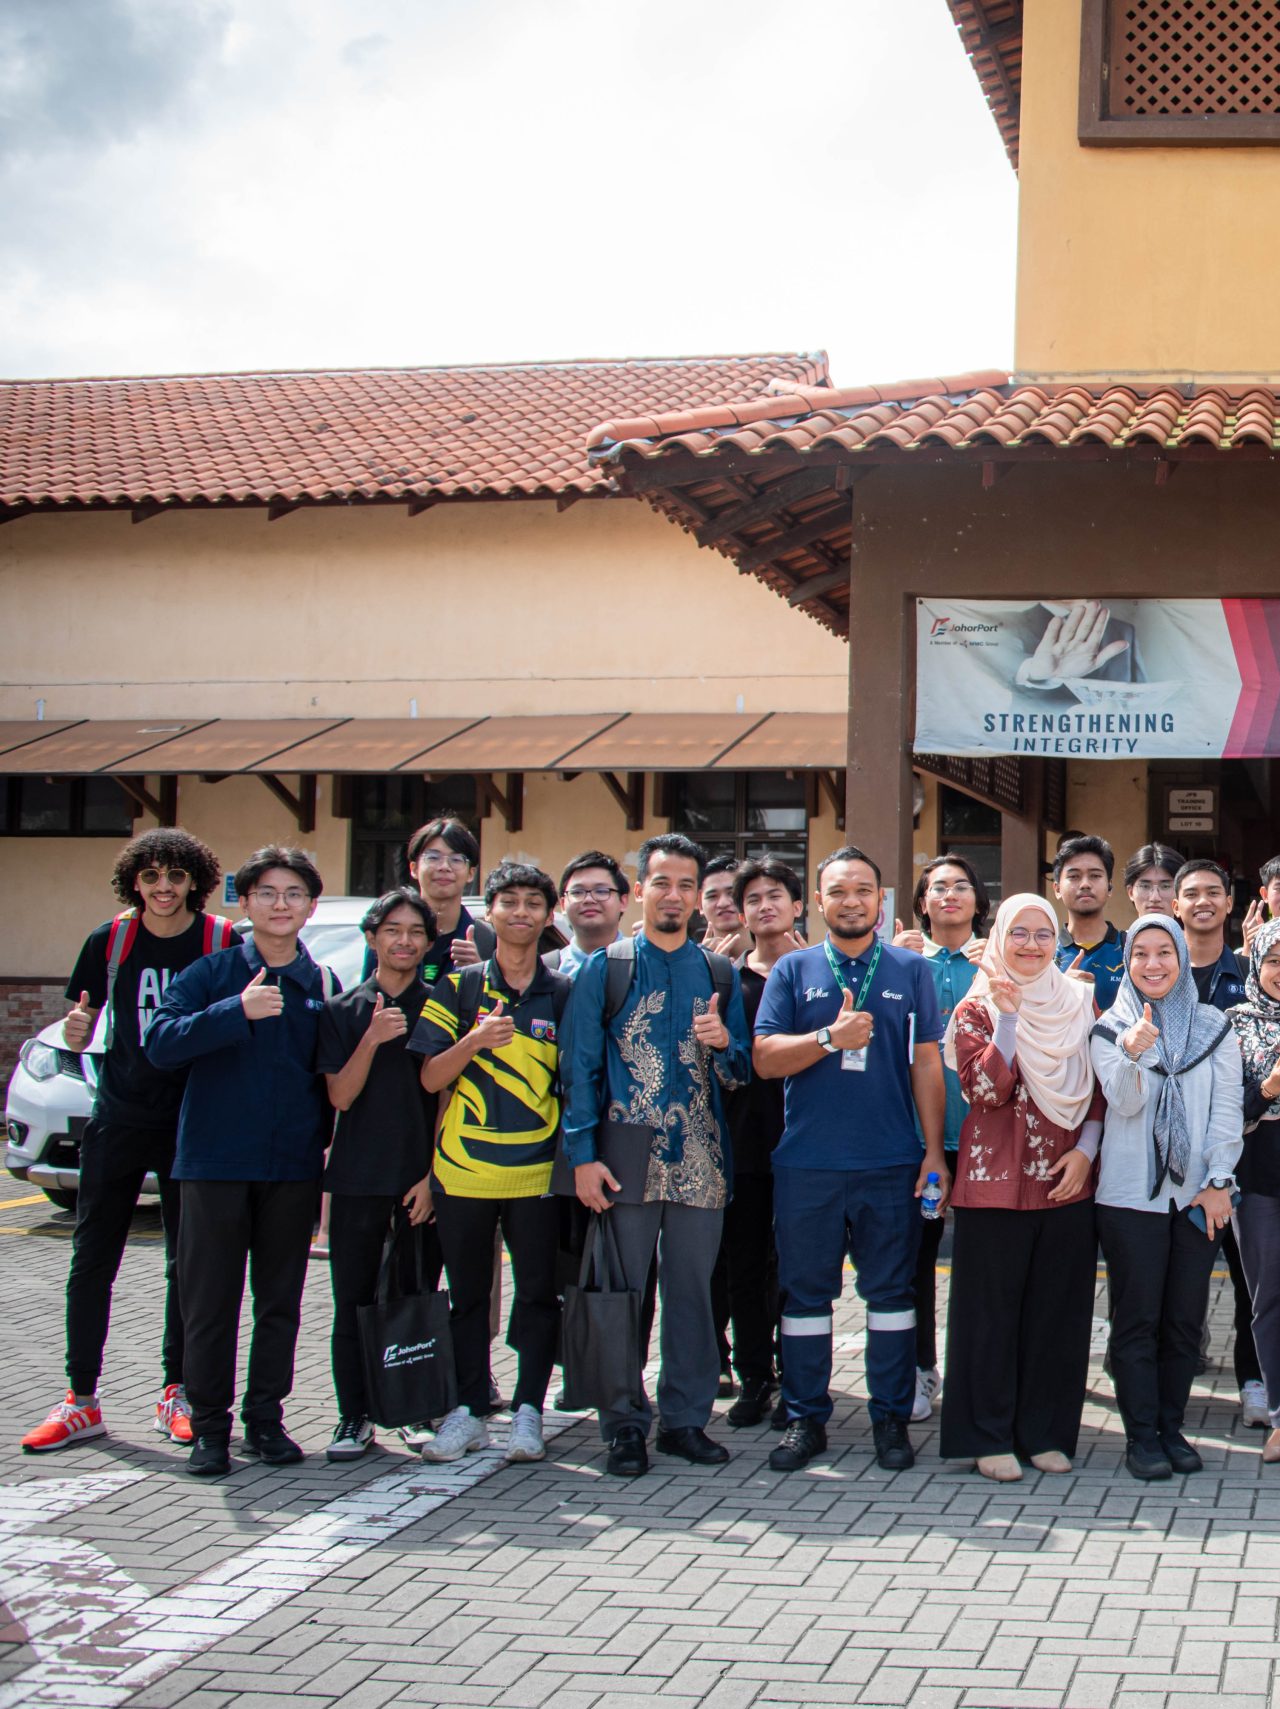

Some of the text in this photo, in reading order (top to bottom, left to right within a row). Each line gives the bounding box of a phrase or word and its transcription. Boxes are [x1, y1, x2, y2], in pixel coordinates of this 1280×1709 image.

[949, 623, 999, 633] JohorPort
[983, 713, 1175, 733] STRENGTHENING
[1013, 737, 1138, 753] INTEGRITY
[397, 1340, 433, 1356] JohorPort
